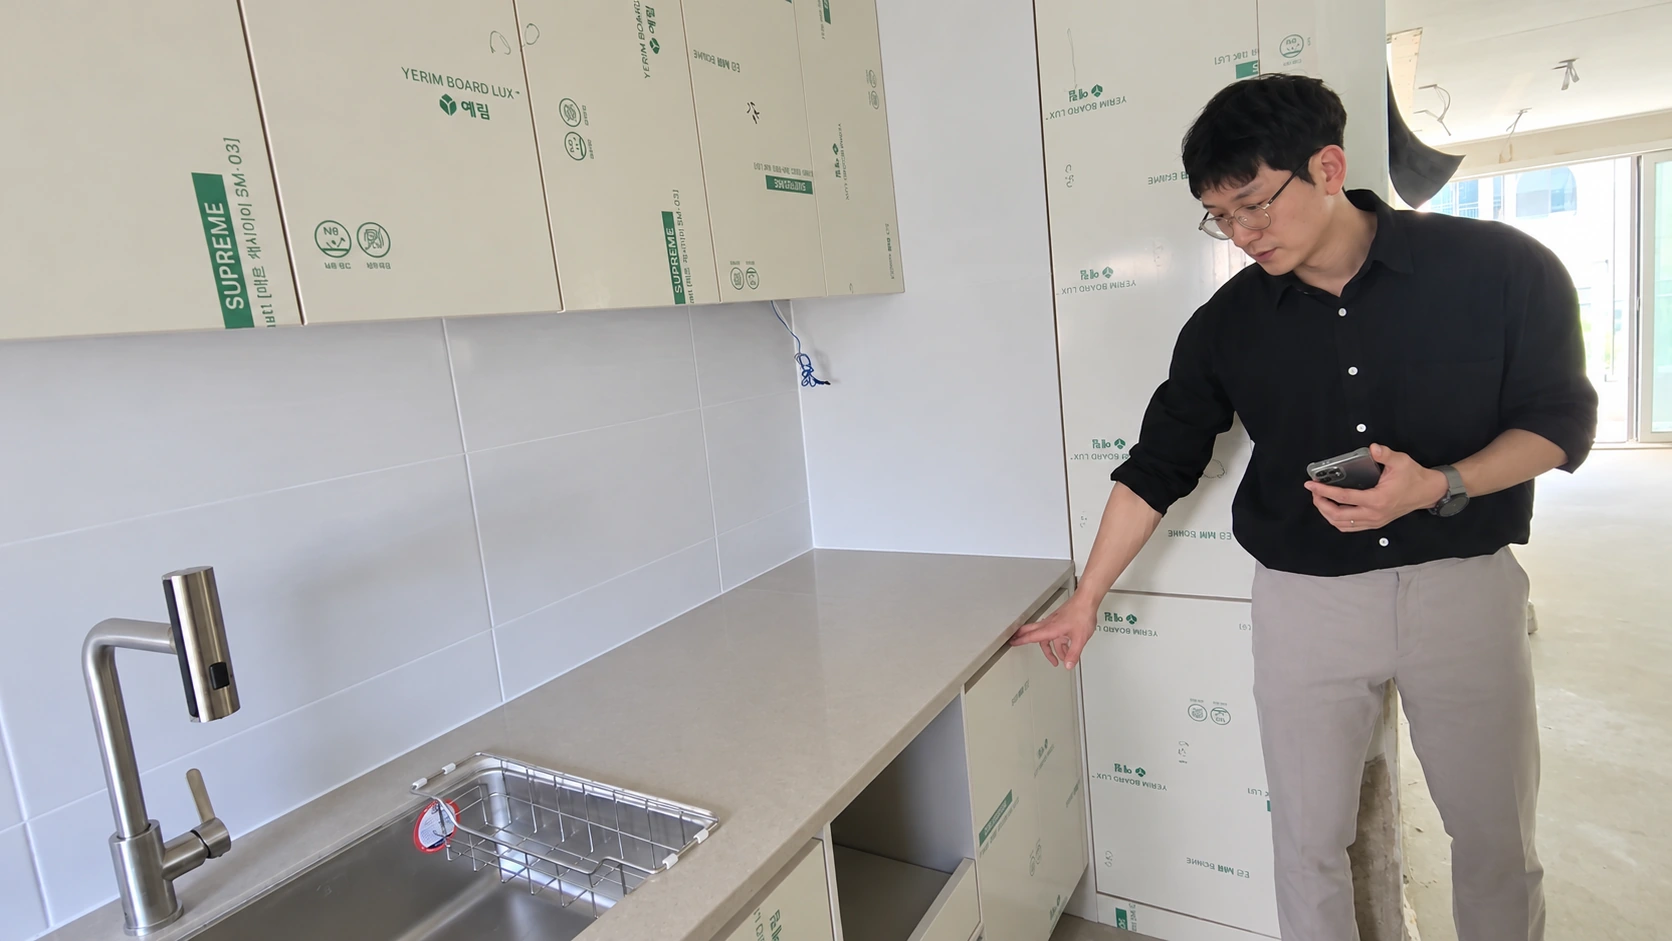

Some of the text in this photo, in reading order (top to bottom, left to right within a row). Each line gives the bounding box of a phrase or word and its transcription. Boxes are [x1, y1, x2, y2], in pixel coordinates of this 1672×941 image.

[640, 42, 651, 79] YERIM
[401, 66, 444, 86] YERIM
[446, 76, 490, 95] BOARD
[461, 100, 490, 120] 예림
[1067, 102, 1098, 116] BOARD
[1099, 95, 1127, 108] YERIM
[204, 202, 244, 310] SUPREME
[666, 228, 682, 293] SUPREME
[1079, 282, 1108, 293] BOARD
[1109, 280, 1137, 290] YERIM
[1132, 627, 1159, 637] YERIM
